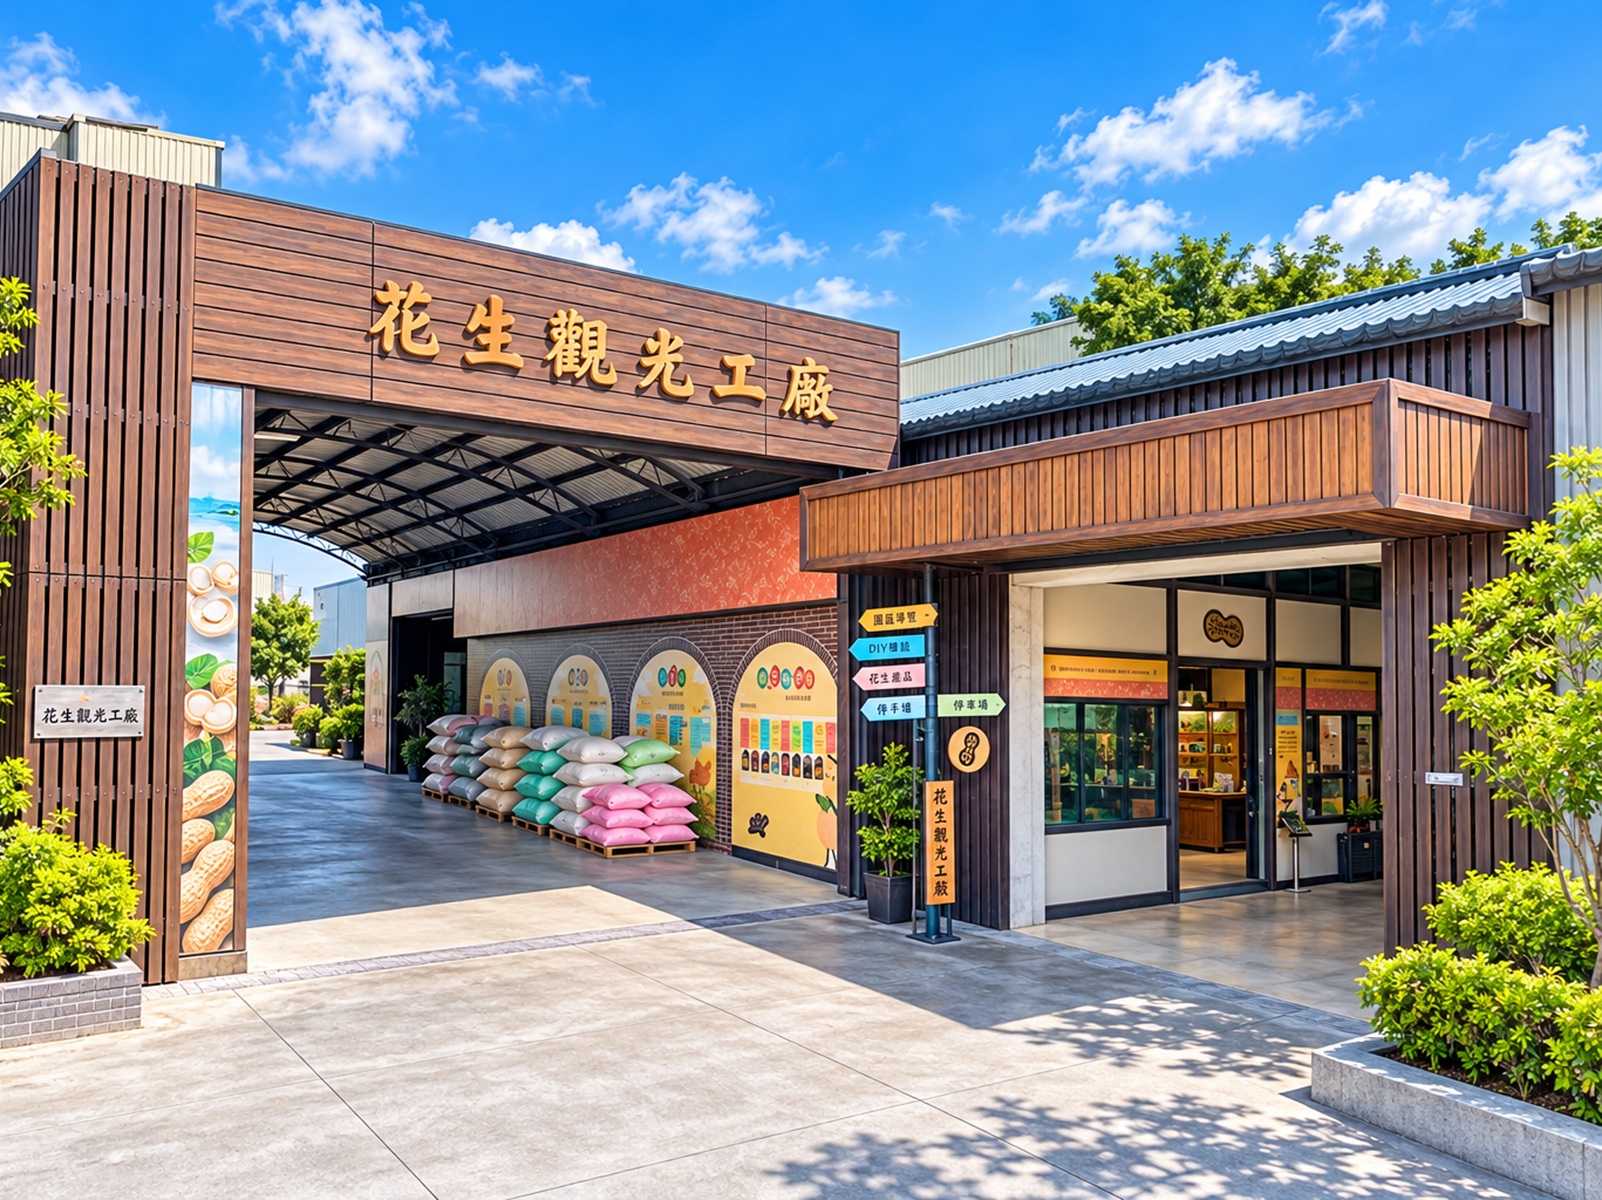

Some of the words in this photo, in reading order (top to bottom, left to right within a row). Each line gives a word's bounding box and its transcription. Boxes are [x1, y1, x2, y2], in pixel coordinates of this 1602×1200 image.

[369, 279, 839, 423] 花生觀光工廠
[42, 707, 139, 724] 花生觀光工廠
